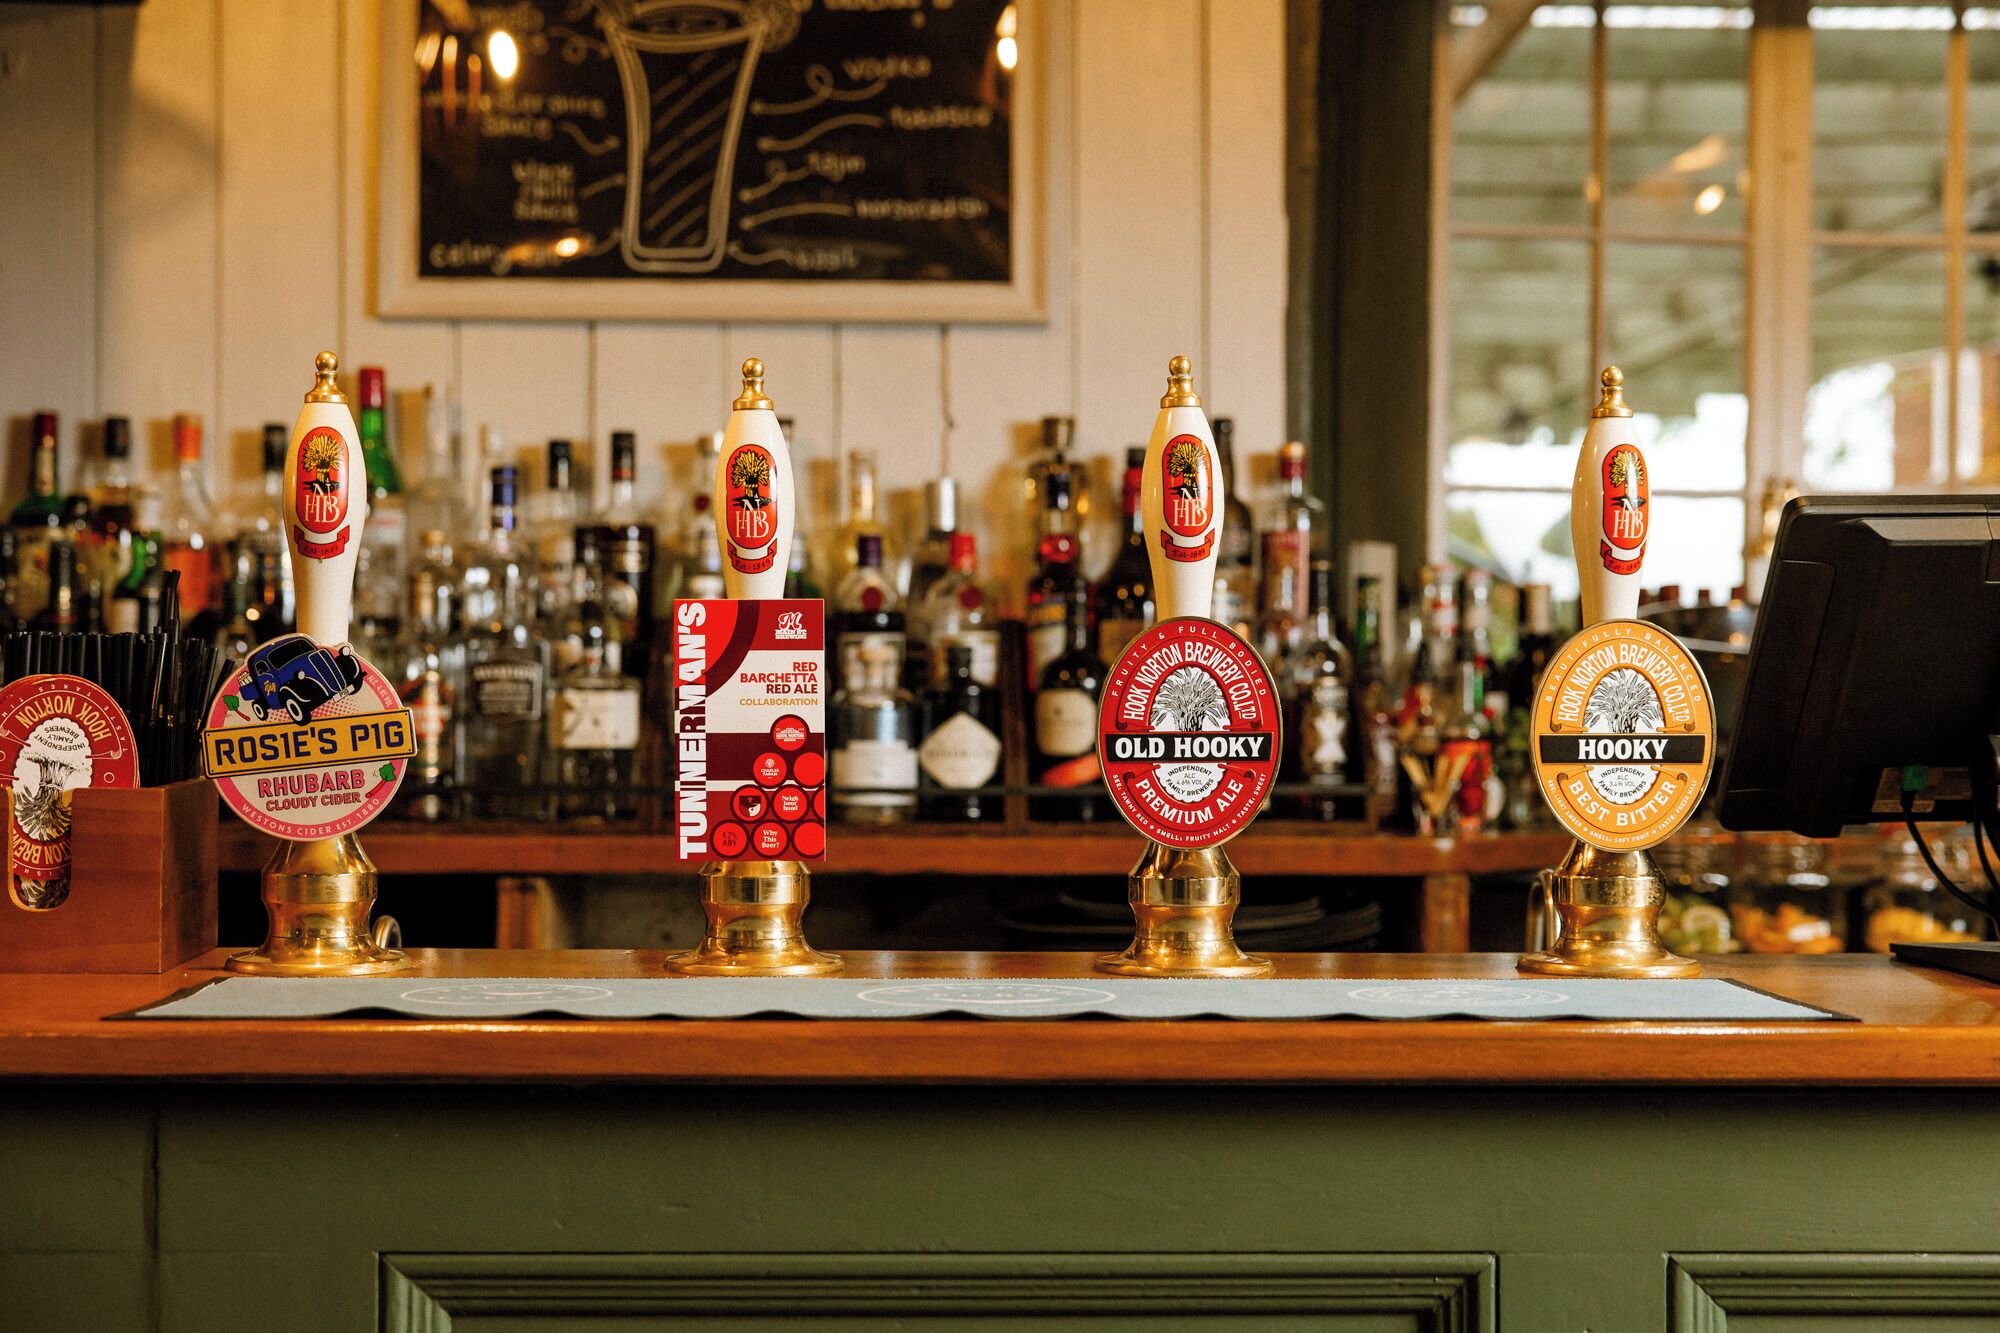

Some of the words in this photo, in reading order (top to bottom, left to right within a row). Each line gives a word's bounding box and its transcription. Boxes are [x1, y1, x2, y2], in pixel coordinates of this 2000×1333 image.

[793, 662, 818, 672] RED
[1112, 643, 1149, 697] FRUITY
[1179, 626, 1217, 639] FULL
[1229, 642, 1267, 696] BODIED
[1135, 643, 1183, 689] NORTON
[1184, 641, 1244, 685] BREWERY
[1545, 628, 1632, 702] BEAUTIFULLY
[1644, 633, 1701, 702] BALANCED
[1570, 646, 1618, 691] NORTON
[1619, 643, 1679, 687] BREWERY
[740, 673, 817, 683] BARCHETTA
[766, 684, 791, 694] RED
[794, 684, 818, 694] ALE
[39, 684, 93, 697] TAKES
[739, 698, 818, 706] COLLABORATION
[1, 697, 24, 718] TIM
[15, 695, 76, 729] NORTON
[1123, 684, 1151, 721] HOOK
[1557, 686, 1584, 722] HOOK
[44, 726, 80, 739] BREWERS
[76, 702, 112, 741] HOOK
[104, 706, 128, 752] TASTE
[34, 734, 86, 752] INDEPENDENT
[47, 734, 73, 743] FAMILY
[1115, 737, 1165, 759] OLD
[1174, 736, 1265, 758] HOOKY
[1578, 739, 1669, 760] HOOKY
[1167, 765, 1213, 776] INDEPENDENT
[1600, 767, 1646, 778] INDEPENDENT
[257, 769, 365, 798] RHUBARB
[1165, 779, 1186, 796] FAMILY
[1186, 778, 1215, 796] BREWERS
[1598, 780, 1619, 797] FAMILY
[1619, 780, 1647, 798] BREWERS
[266, 796, 318, 811] CLOUDY
[321, 792, 361, 806] CIDER
[1120, 791, 1137, 814] TAWNY
[1136, 813, 1149, 825] RED
[1185, 833, 1211, 842] FRUITY
[1213, 823, 1231, 836] MALT
[1253, 773, 1267, 796] SWEET
[1136, 778, 1214, 825] PREMIUM
[1216, 780, 1244, 812] ALE
[1569, 780, 1610, 822] BEST
[1616, 781, 1677, 826] BITTER
[241, 804, 292, 834] WESTONS
[297, 825, 332, 836] CIDER
[356, 799, 379, 819] 1880
[1614, 835, 1630, 843] SOFT
